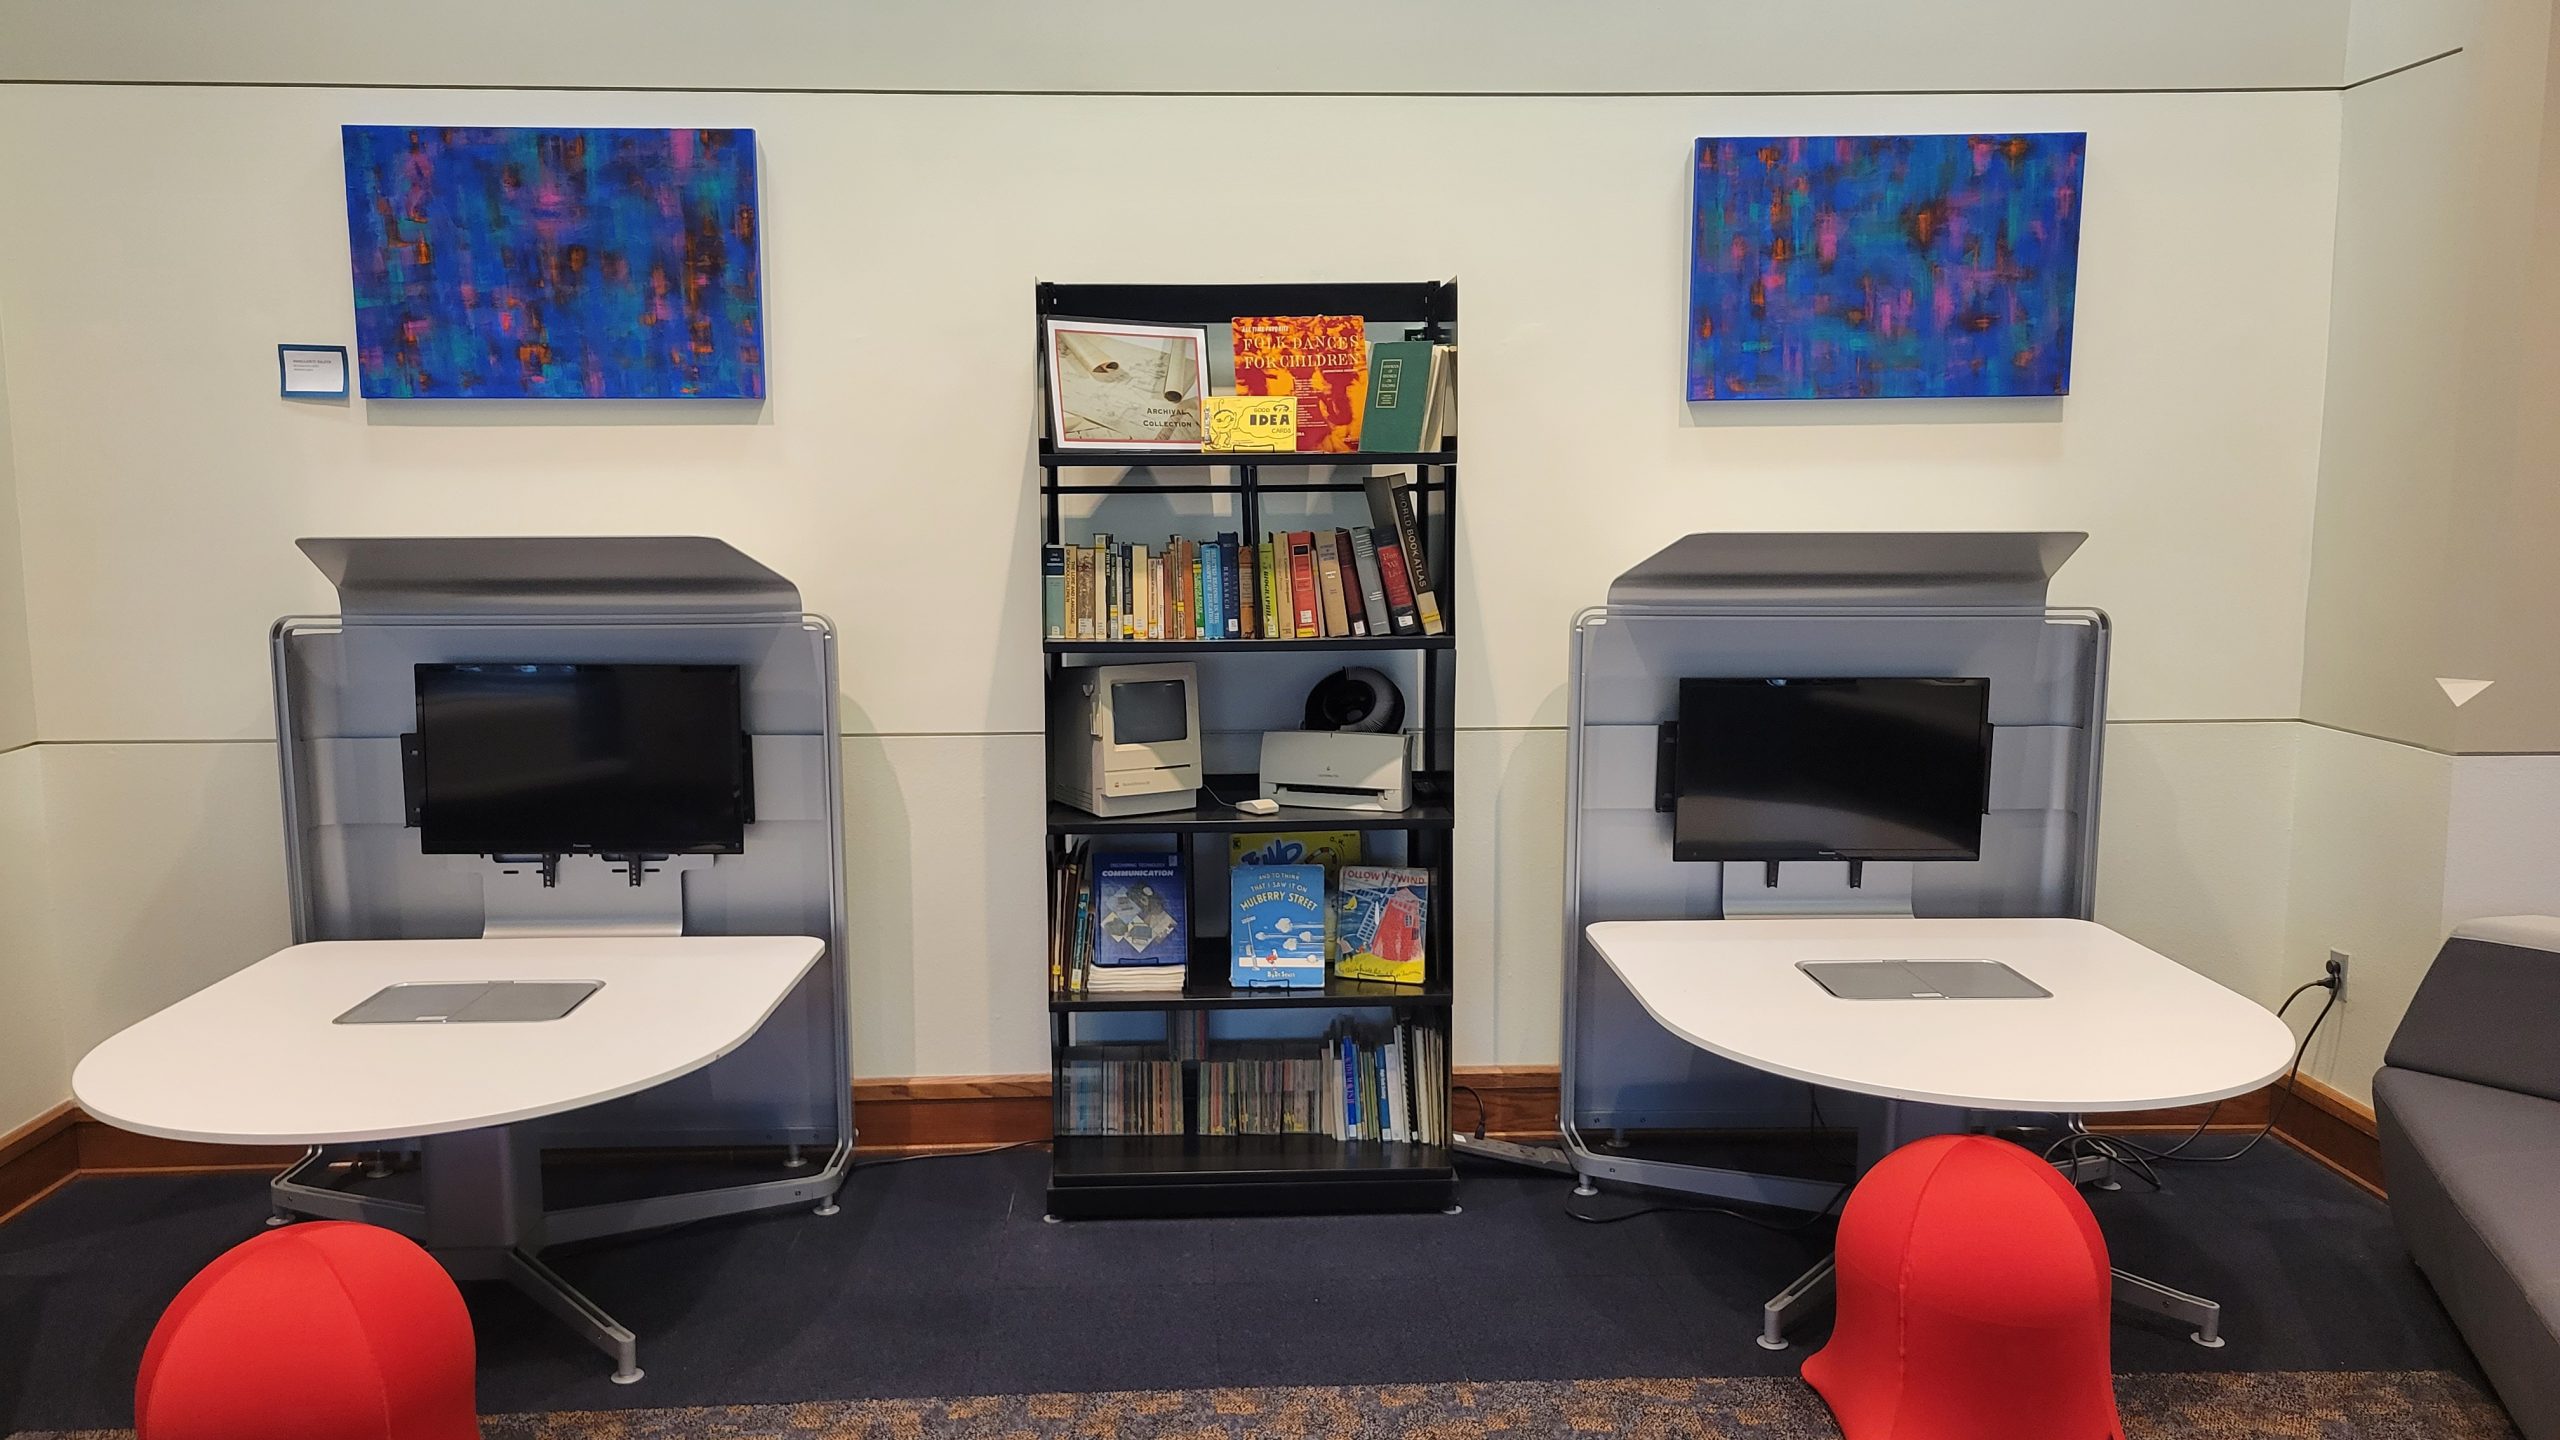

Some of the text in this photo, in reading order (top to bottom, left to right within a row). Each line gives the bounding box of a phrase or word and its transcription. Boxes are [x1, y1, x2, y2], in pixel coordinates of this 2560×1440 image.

[1243, 334, 1359, 351] FOLK DANCES
[1244, 353, 1359, 369] FOR CHILDREN
[1146, 407, 1186, 415] ARCHIVAL
[1249, 414, 1290, 426] IDEA
[1398, 491, 1427, 588] WORLD BOOK ATLAS
[1102, 869, 1174, 877] COMMUNICATION
[1397, 874, 1425, 884] WIND
[1250, 882, 1266, 892] THAT
[1296, 885, 1308, 893] ON
[1240, 891, 1318, 911] MULBERRY STREET
